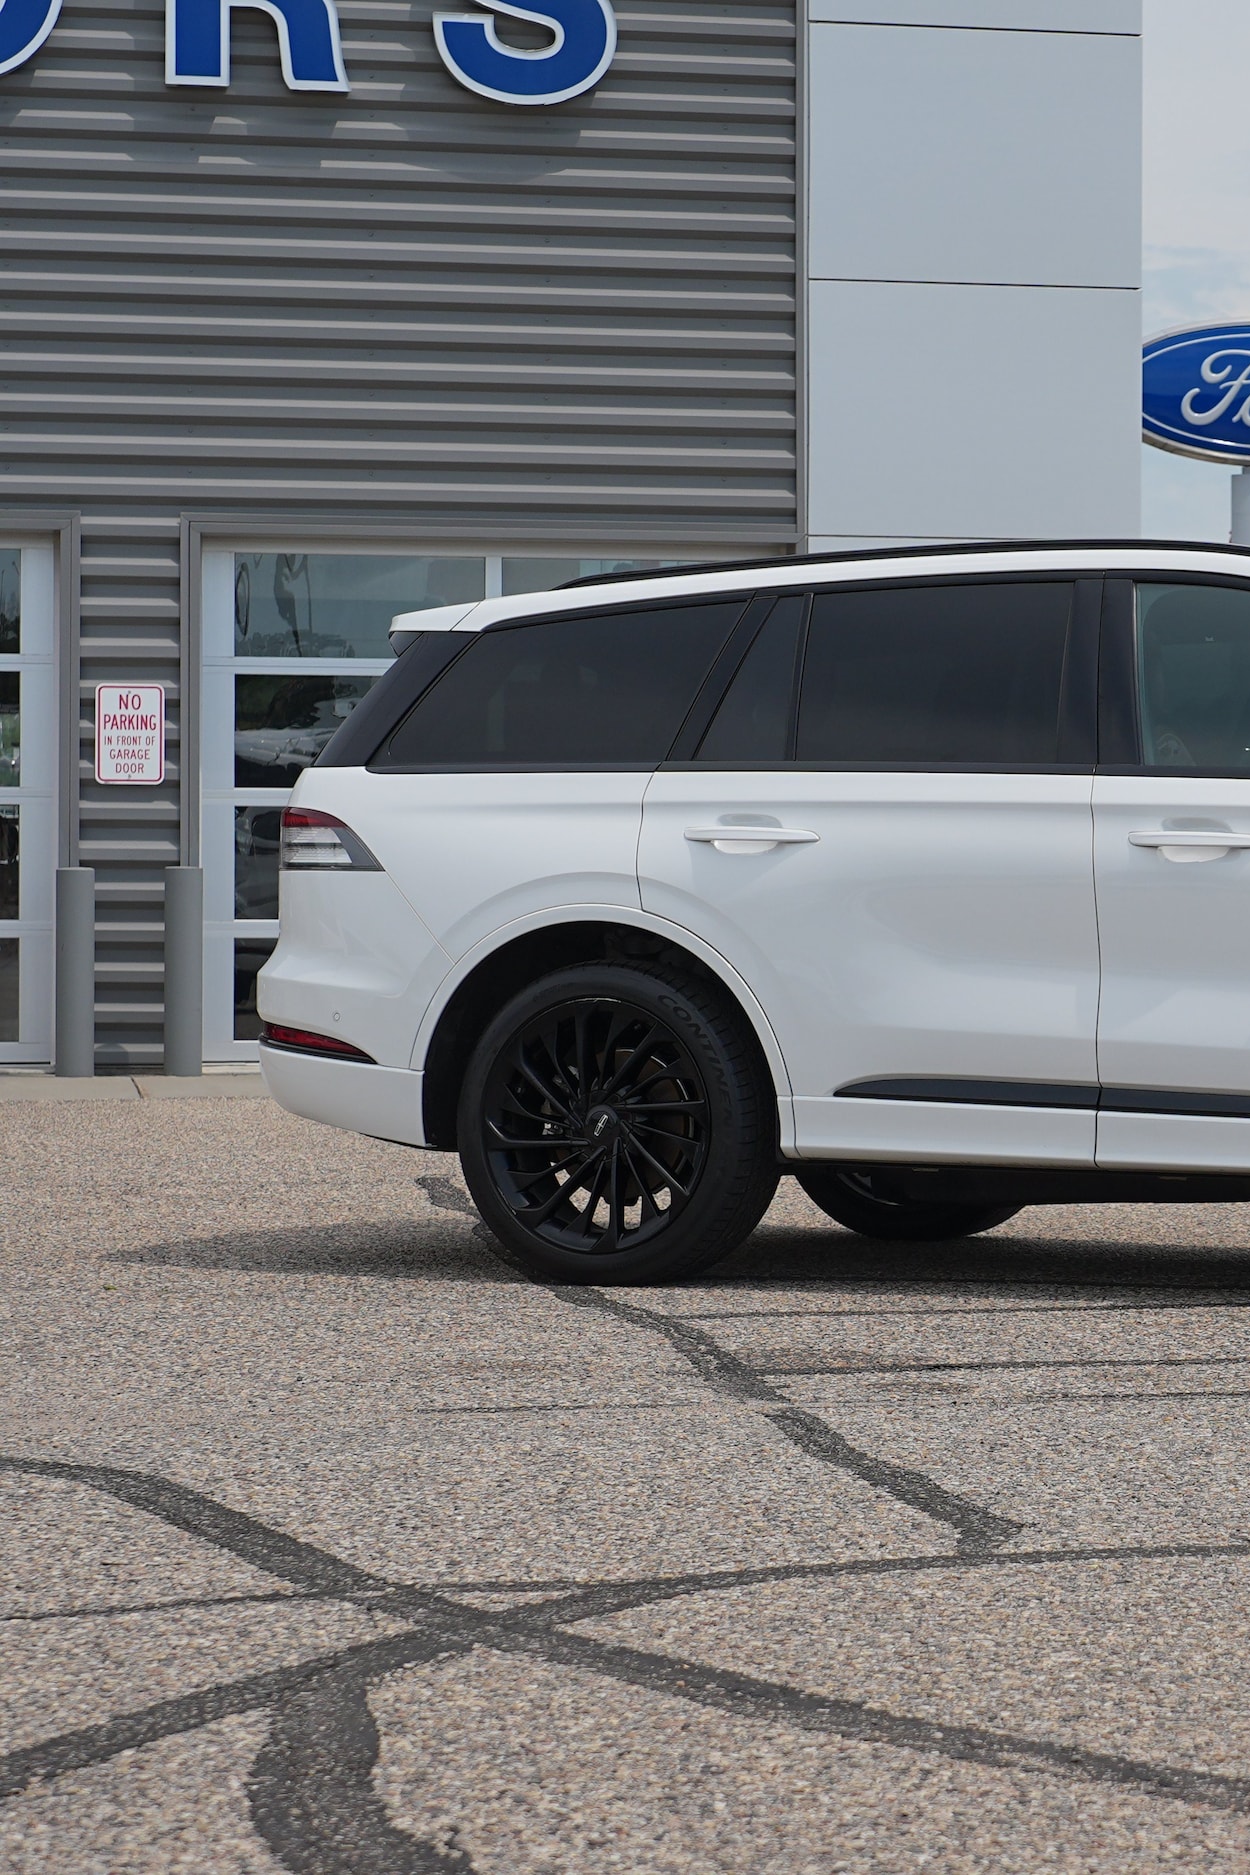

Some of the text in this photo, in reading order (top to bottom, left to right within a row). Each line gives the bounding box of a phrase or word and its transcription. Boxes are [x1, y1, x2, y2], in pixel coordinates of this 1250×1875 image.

[118, 694, 142, 710] NO
[103, 714, 157, 731] PARKING
[104, 735, 156, 746] IN FRONT OF
[109, 749, 150, 760] GARAGE
[115, 763, 145, 774] DOOR
